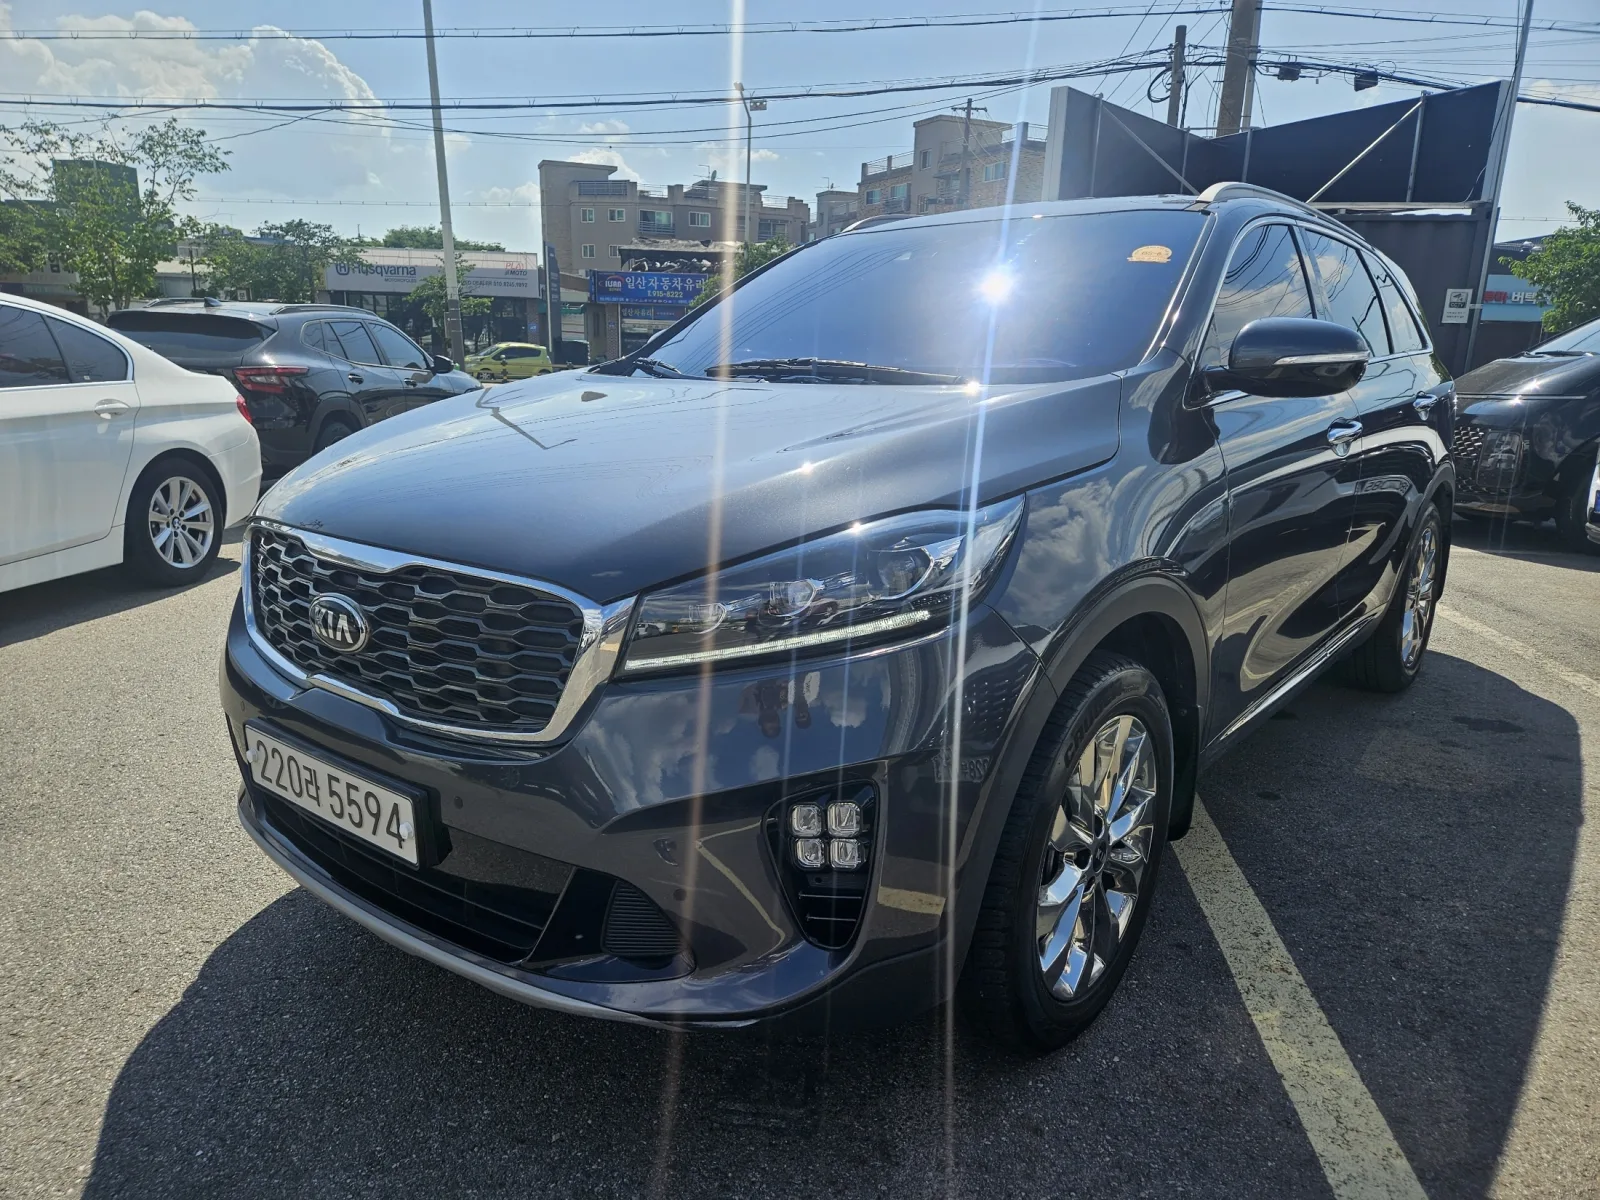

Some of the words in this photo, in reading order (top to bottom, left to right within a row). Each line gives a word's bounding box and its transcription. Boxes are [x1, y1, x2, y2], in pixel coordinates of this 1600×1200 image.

[625, 276, 705, 292] 일산자동차유리
[313, 606, 354, 644] KIA
[256, 740, 321, 808] 220라
[327, 773, 405, 850] 5594
